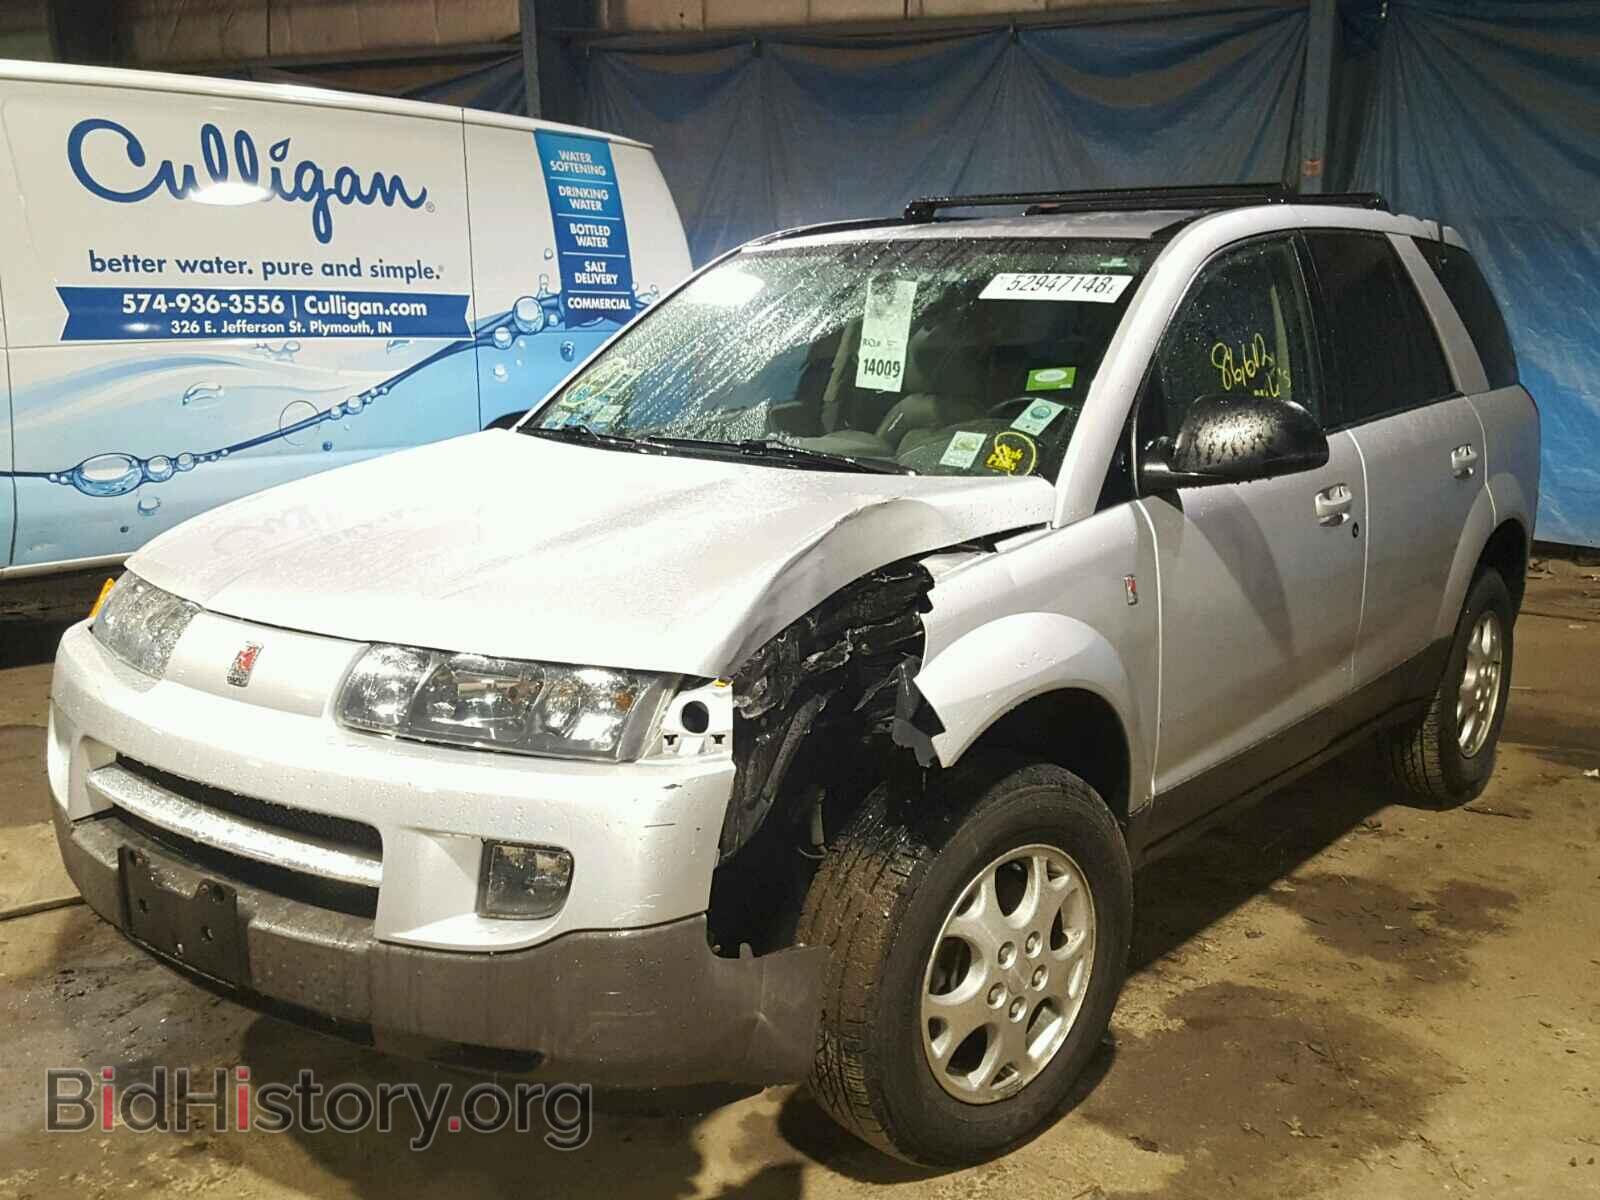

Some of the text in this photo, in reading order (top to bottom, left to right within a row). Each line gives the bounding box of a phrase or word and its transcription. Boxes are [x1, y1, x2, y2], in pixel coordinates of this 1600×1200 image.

[558, 150, 592, 162] WATER
[550, 161, 606, 176] SOFTENING
[67, 117, 428, 243] Culligan
[558, 186, 609, 200] DRINKING
[569, 198, 602, 211] WATER
[569, 223, 611, 236] BOTTLED
[575, 235, 608, 248] WATER
[89, 249, 441, 285] better water. pure and simple.
[584, 260, 606, 272] SALT
[574, 272, 618, 285] DELIVERY
[122, 293, 428, 318] 574-936-3556 Culligan.com
[567, 297, 632, 310] COMMERCIAL
[171, 320, 392, 337] 326 E. Jefferson St. Plymouth, IN
[863, 358, 901, 378] 14009
